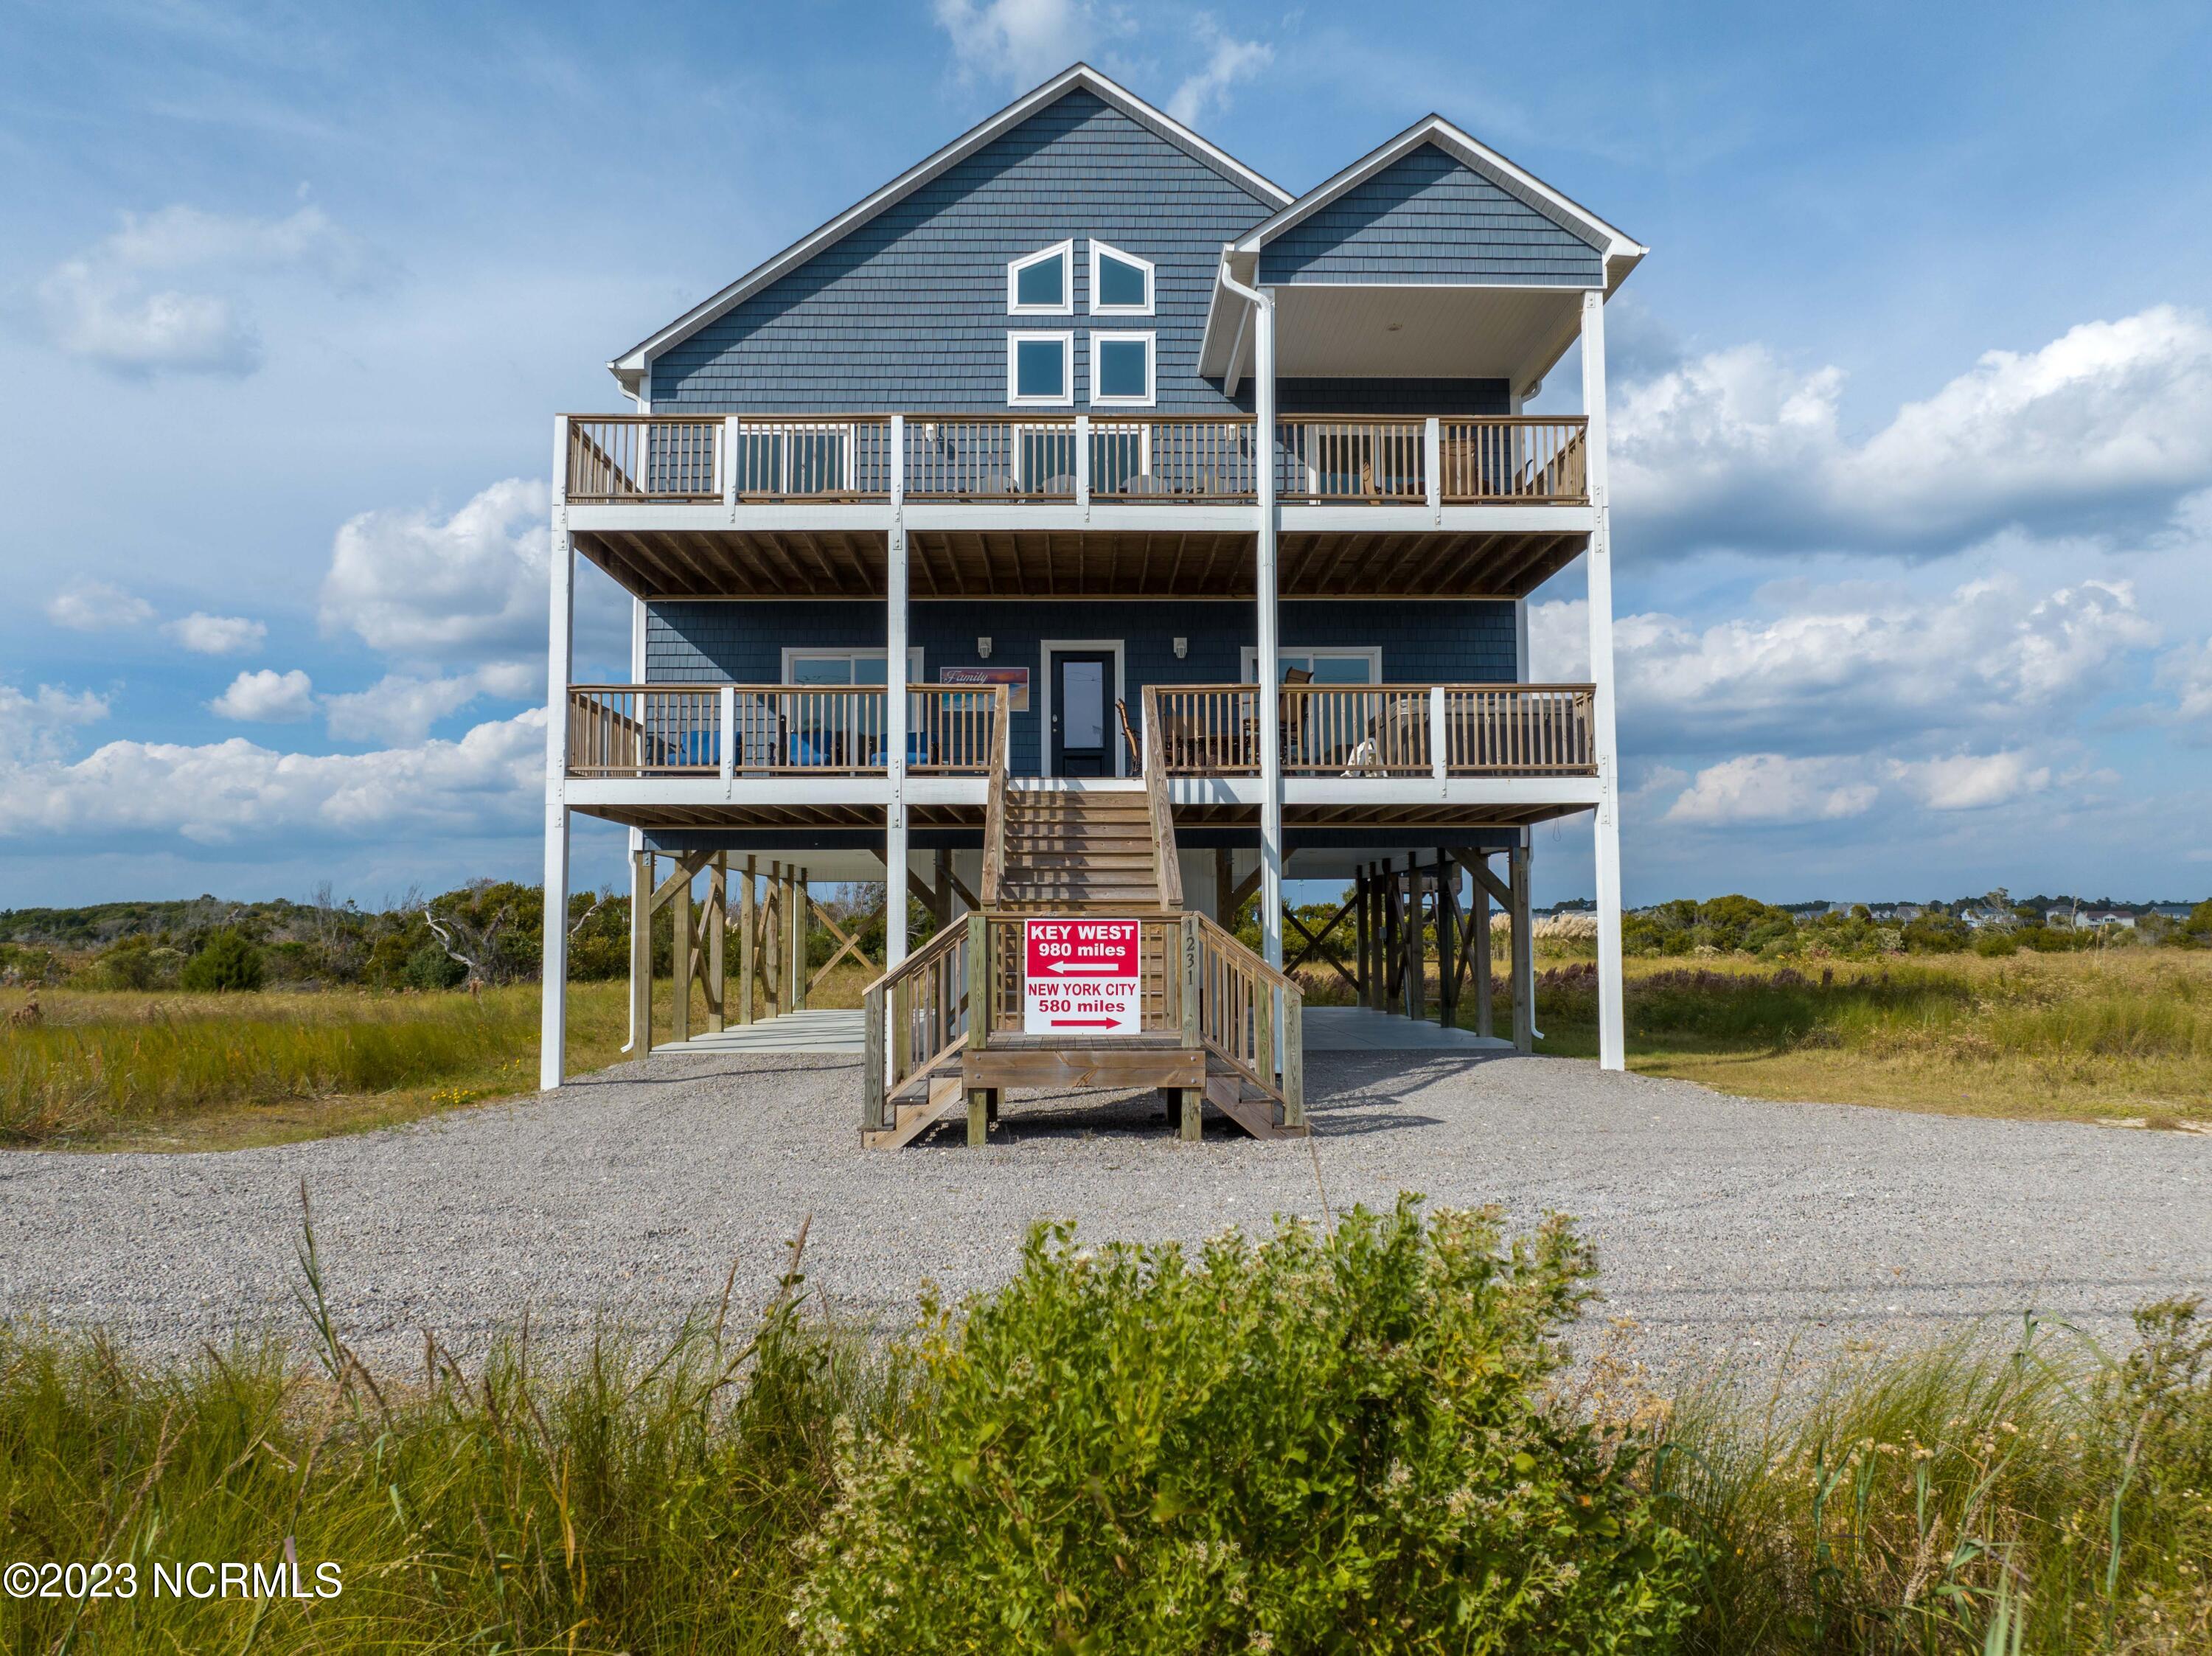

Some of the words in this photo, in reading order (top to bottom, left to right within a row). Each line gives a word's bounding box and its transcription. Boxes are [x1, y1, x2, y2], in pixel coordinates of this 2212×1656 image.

[943, 670, 989, 684] Family
[1031, 925, 1072, 940] KEY
[1077, 925, 1134, 940] WEST
[1039, 943, 1072, 956] 980
[1077, 943, 1126, 956] miles
[1186, 919, 1195, 985] 1231
[1028, 983, 1059, 996] NEW
[1062, 983, 1102, 996] YORK
[1105, 983, 1136, 996] CITY
[1038, 999, 1071, 1012] 580
[1077, 999, 1126, 1012] miles
